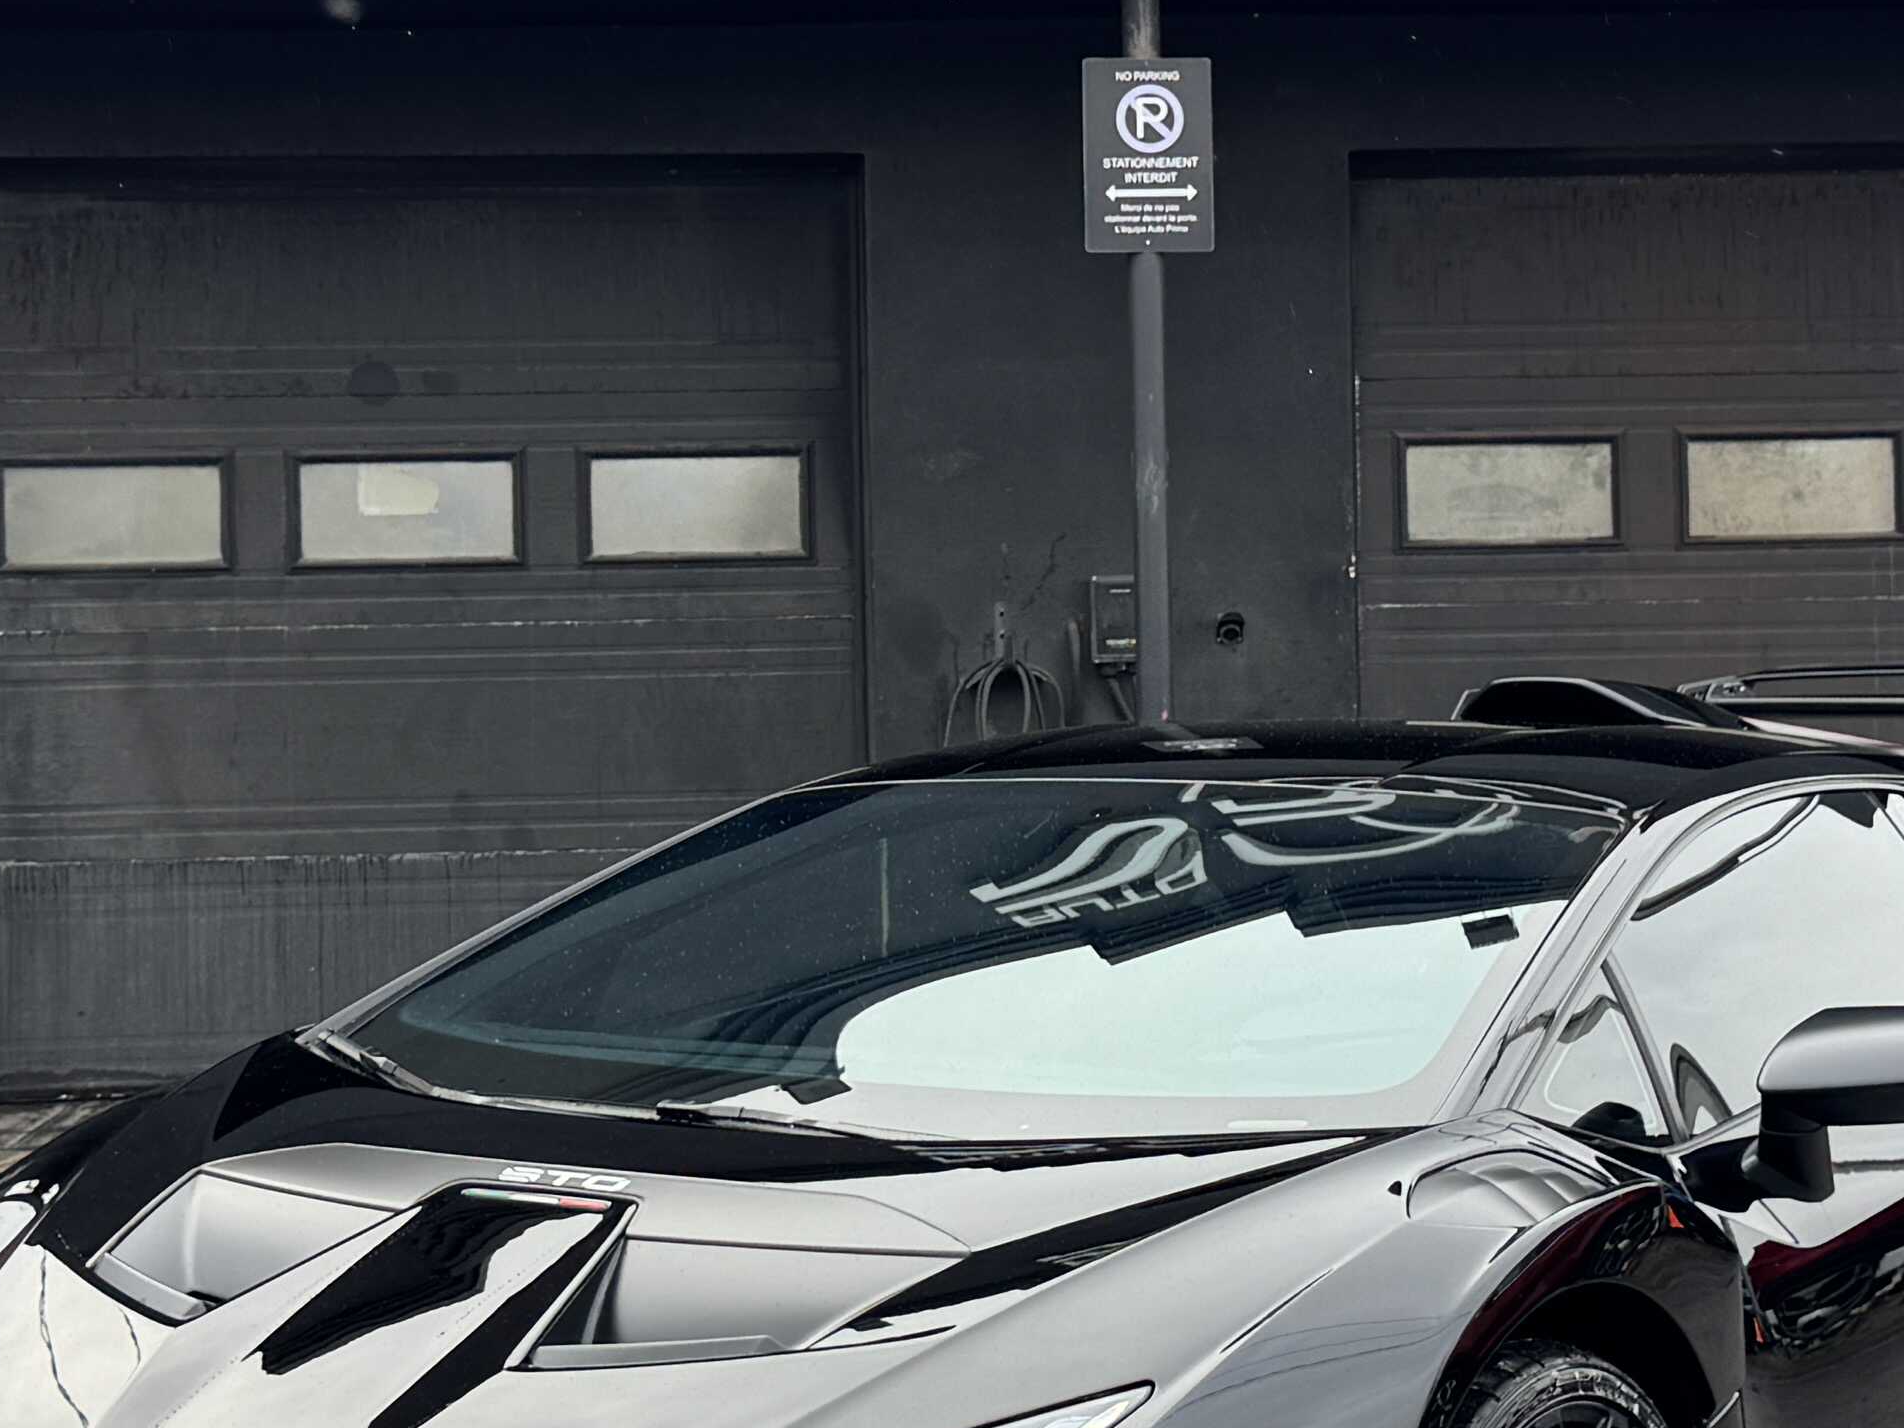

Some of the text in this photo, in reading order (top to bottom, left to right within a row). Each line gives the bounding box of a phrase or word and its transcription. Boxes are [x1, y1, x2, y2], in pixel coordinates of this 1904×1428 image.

[1115, 70, 1180, 81] NO PARKING
[1102, 156, 1199, 169] STATIONNEMENT
[1124, 172, 1178, 184] INTERDIT
[498, 1165, 632, 1192] STO
